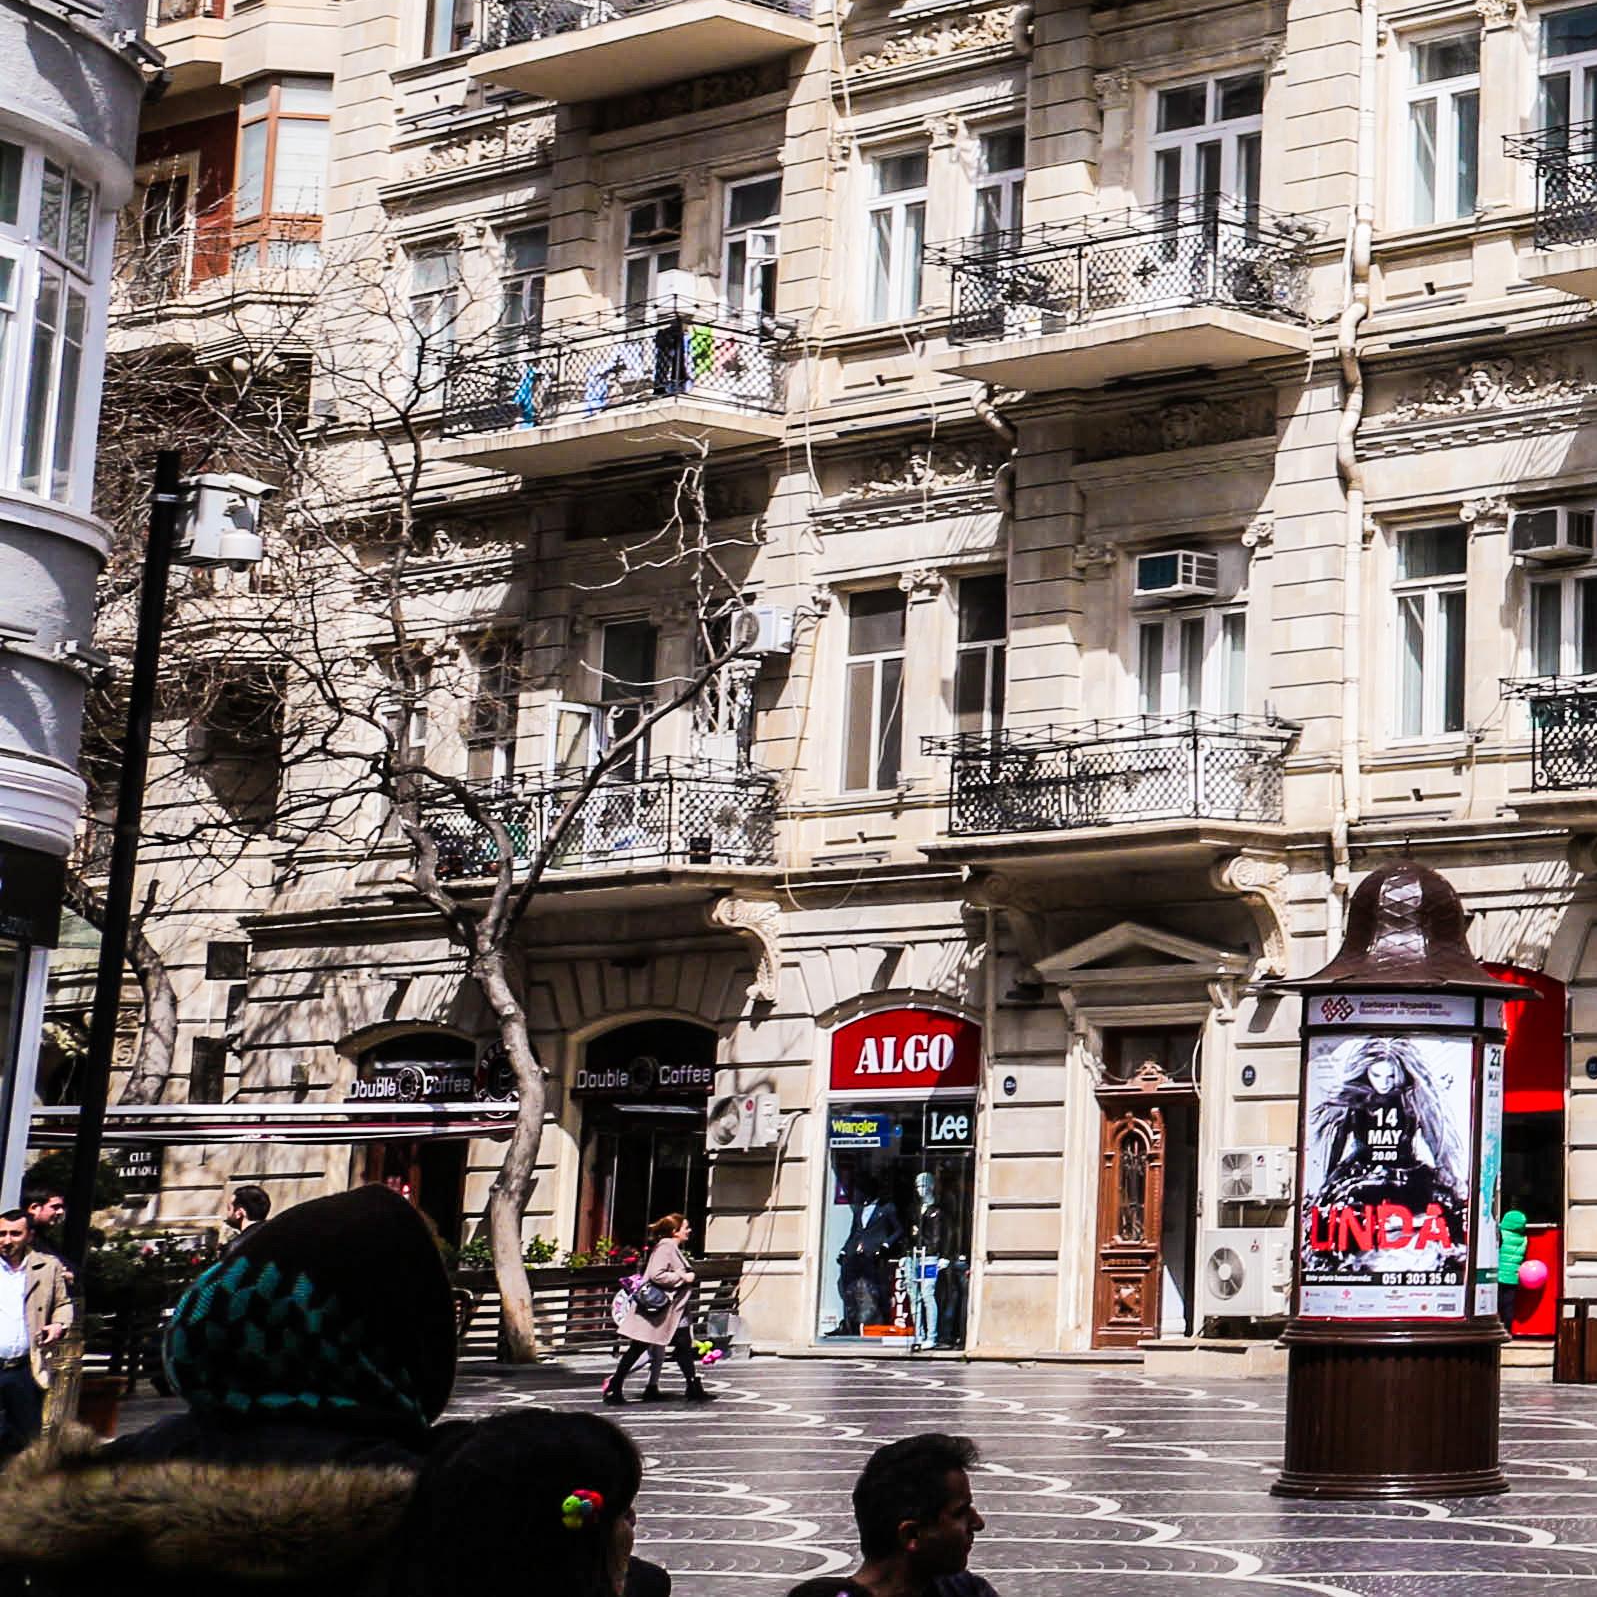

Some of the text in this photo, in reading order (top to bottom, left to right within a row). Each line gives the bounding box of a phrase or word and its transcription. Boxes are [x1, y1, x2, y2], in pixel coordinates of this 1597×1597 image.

[854, 1034, 954, 1074] ALGO
[348, 1074, 472, 1099] Double Coffee
[576, 1065, 712, 1090] Double Coffee
[831, 1119, 878, 1136] Wrangler
[930, 1111, 968, 1141] Lee
[1373, 1107, 1399, 1128] 14
[1368, 1129, 1403, 1145] MAY
[1382, 1272, 1403, 1285] 051
[1406, 1272, 1426, 1285] 303
[1429, 1272, 1442, 1285] 35
[1444, 1272, 1457, 1285] 40
